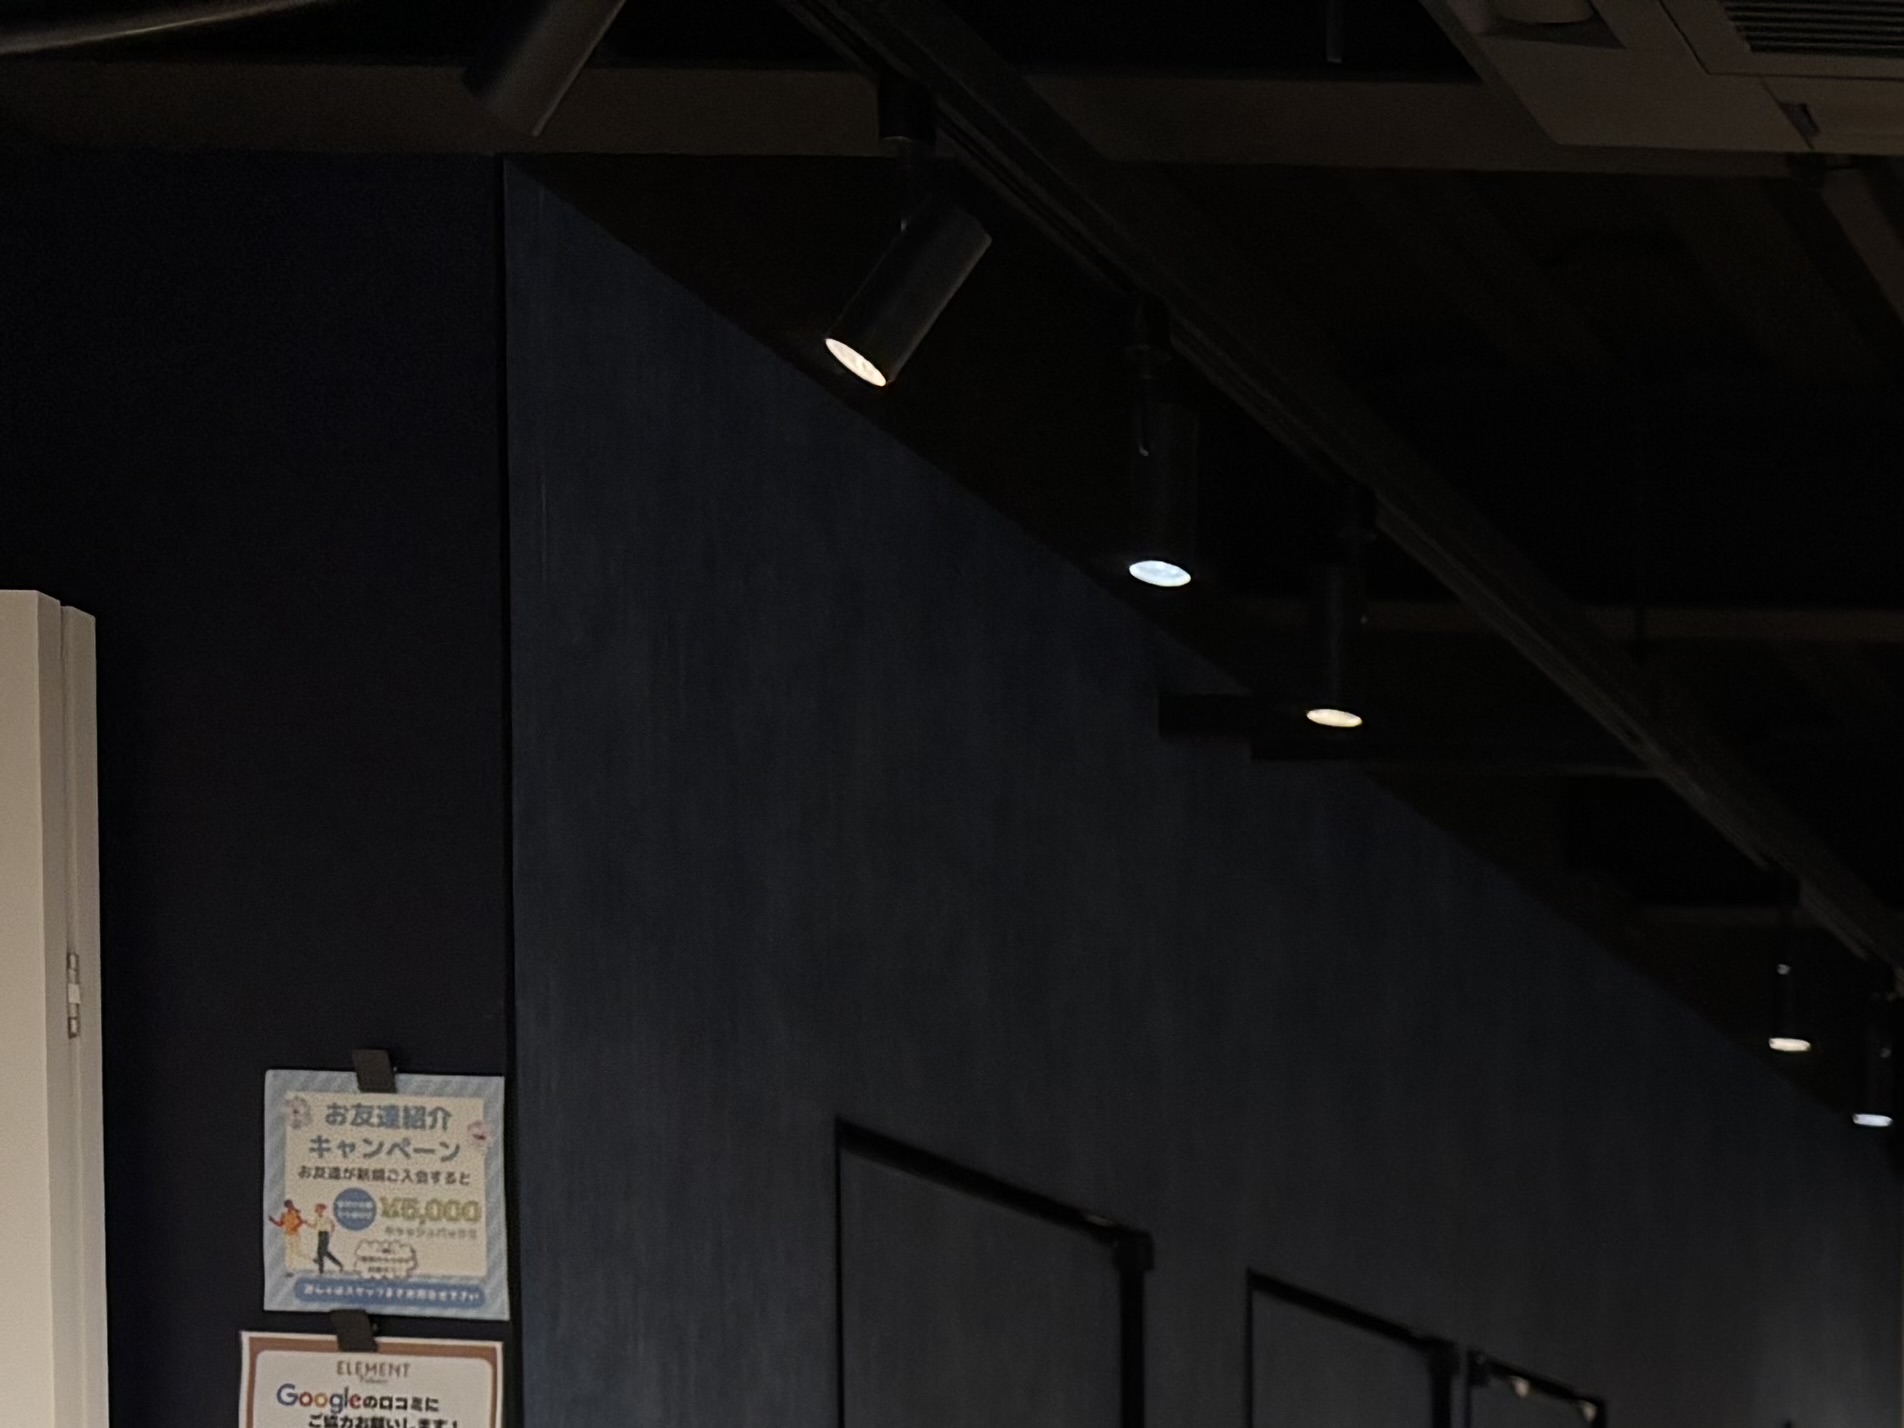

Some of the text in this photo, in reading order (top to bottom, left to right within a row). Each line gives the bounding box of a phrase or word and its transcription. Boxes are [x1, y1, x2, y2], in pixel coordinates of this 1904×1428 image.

[325, 1103, 453, 1131] お友達紹介
[309, 1135, 461, 1163] キャンペーン
[336, 1360, 411, 1378] ELEMENT
